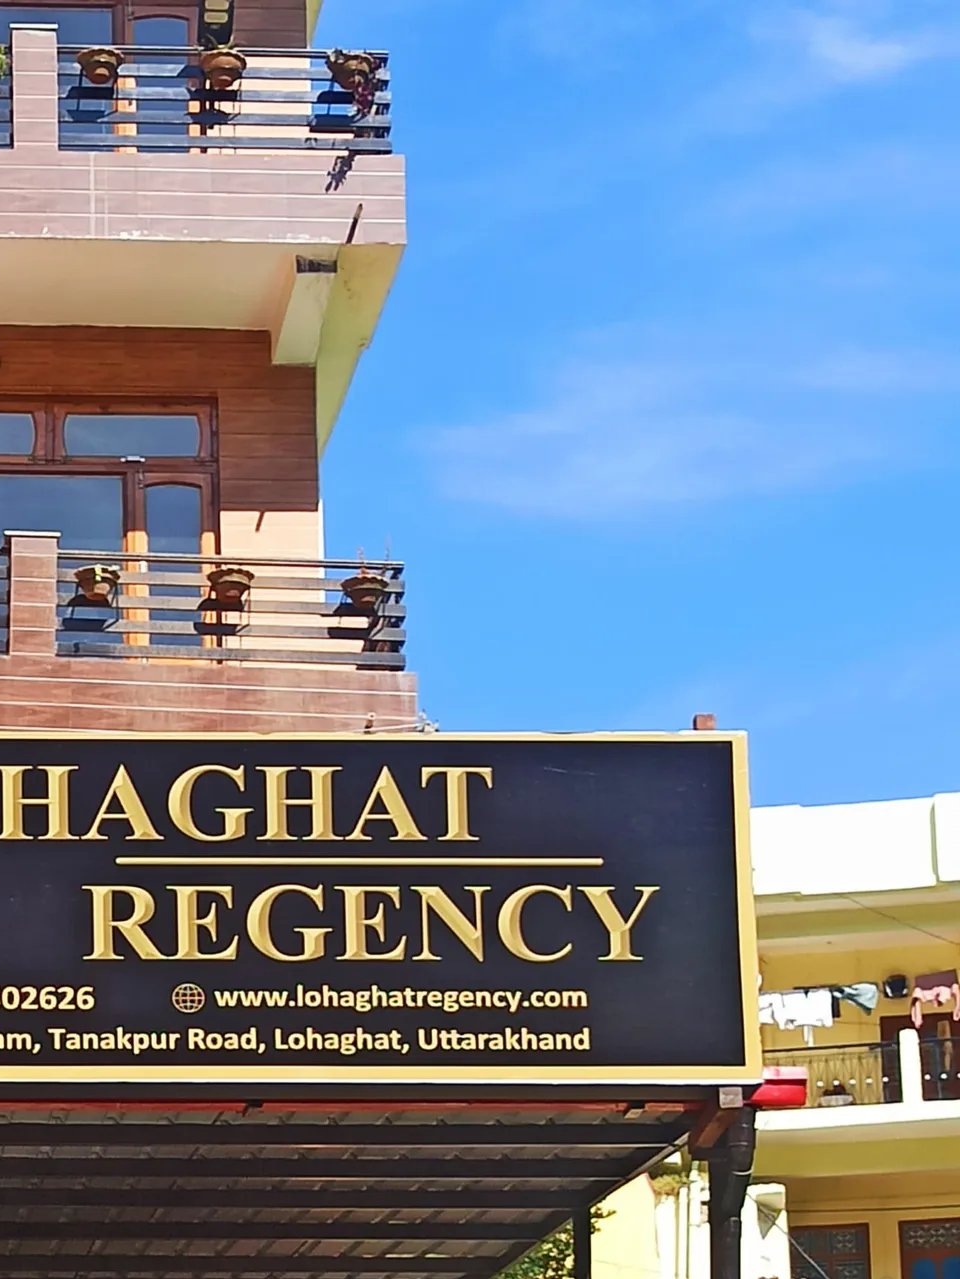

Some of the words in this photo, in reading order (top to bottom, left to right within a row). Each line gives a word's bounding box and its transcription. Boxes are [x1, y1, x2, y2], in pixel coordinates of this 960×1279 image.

[81, 884, 661, 962] REGENCY
[213, 984, 588, 1013] www.lohaghatregency.com
[47, 1026, 181, 1055] Tanakpur
[188, 1027, 266, 1054] Road,
[274, 1027, 410, 1055] Lohaghat,
[418, 1027, 591, 1051] Uttarakhand
